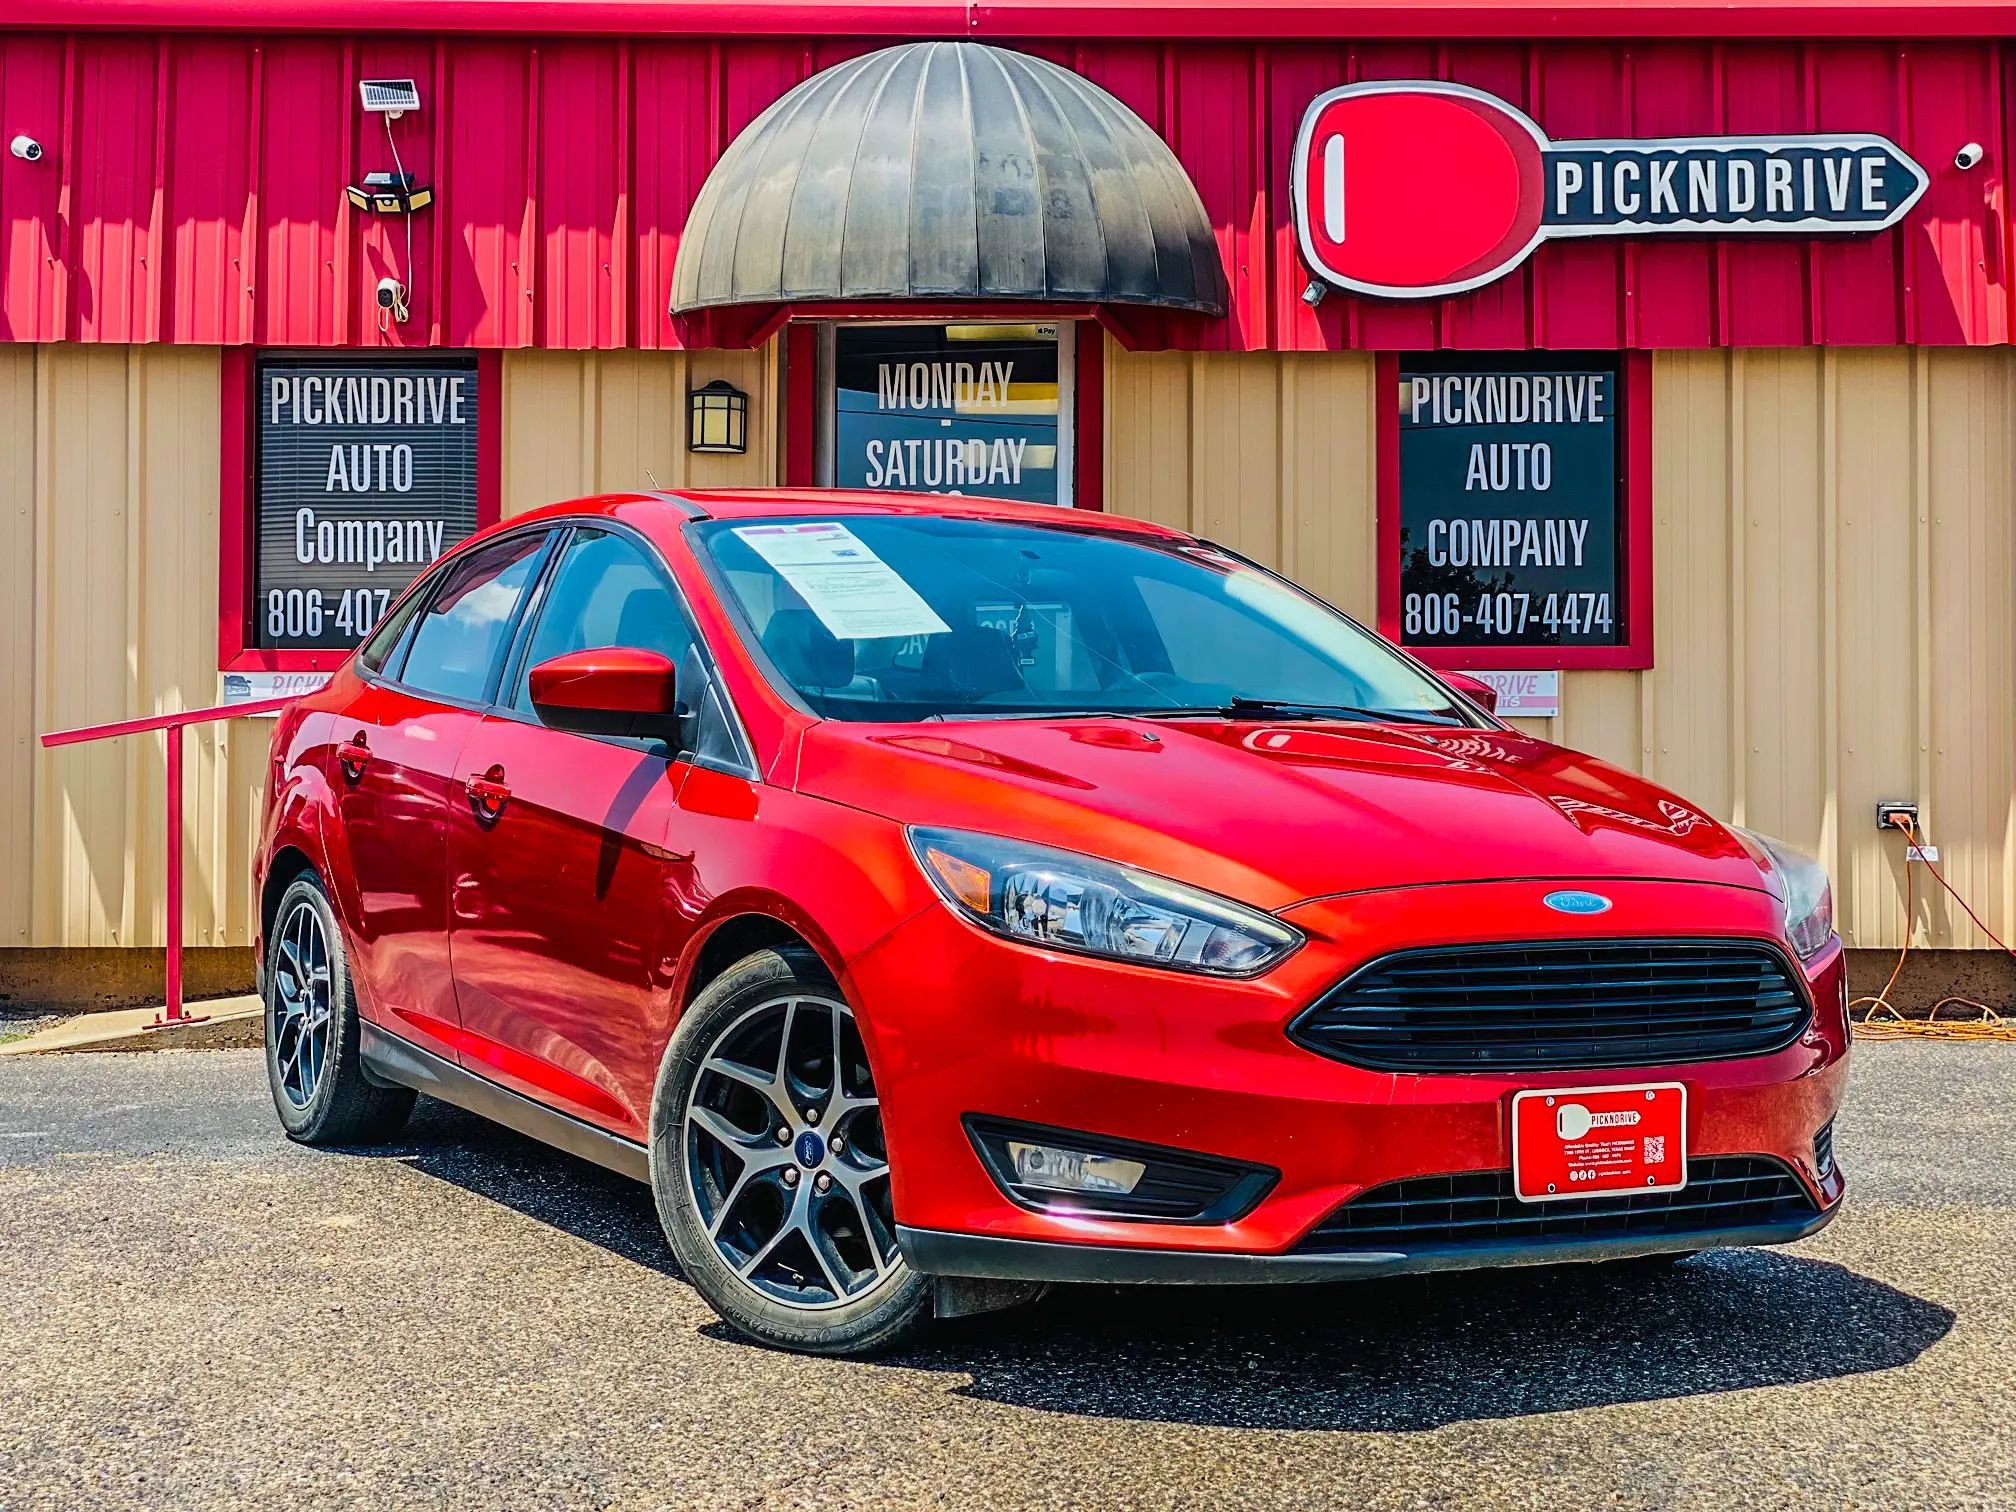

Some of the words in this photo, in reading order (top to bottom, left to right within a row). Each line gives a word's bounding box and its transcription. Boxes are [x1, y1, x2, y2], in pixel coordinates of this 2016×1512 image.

[1556, 156, 1887, 215] PICKNDRIVE
[271, 376, 466, 425] PICKNDRIVE
[878, 361, 1014, 410] MONDAY
[1411, 375, 1604, 424] PICKNDRIVE
[325, 444, 413, 492] AUTO
[865, 437, 1027, 487] SATURDAY
[1465, 443, 1551, 491] AUTO
[296, 507, 444, 572] Company
[1428, 519, 1589, 568] COMPANY
[268, 588, 391, 637] 806-407
[1405, 592, 1613, 635] 806-407-4474
[1591, 1113, 1637, 1125] PICKNDRIVE
